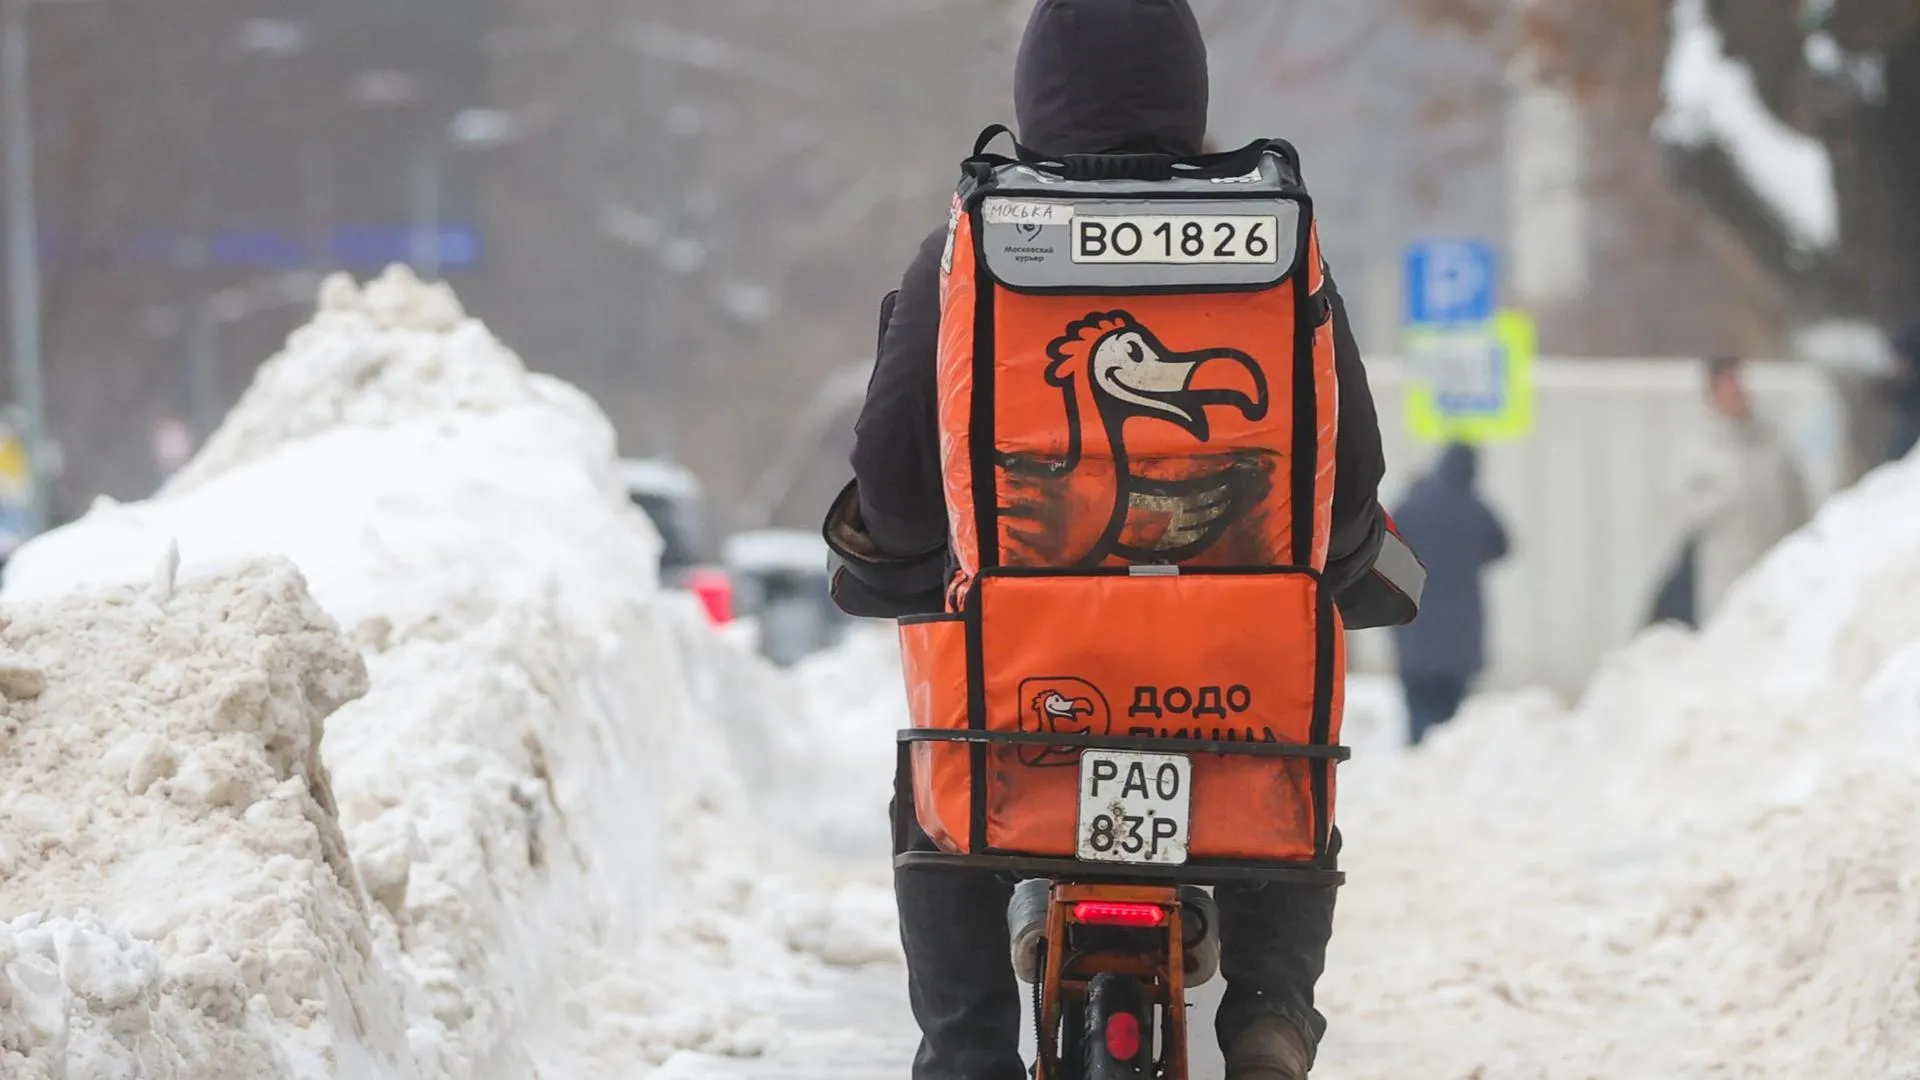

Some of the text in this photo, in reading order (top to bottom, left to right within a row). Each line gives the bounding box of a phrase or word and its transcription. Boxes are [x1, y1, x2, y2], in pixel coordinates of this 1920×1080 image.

[1004, 245, 1055, 254] Московский
[1080, 221, 1269, 257] ВО1826
[1128, 684, 1251, 719] ДОДО
[1090, 814, 1178, 855] 83Р
